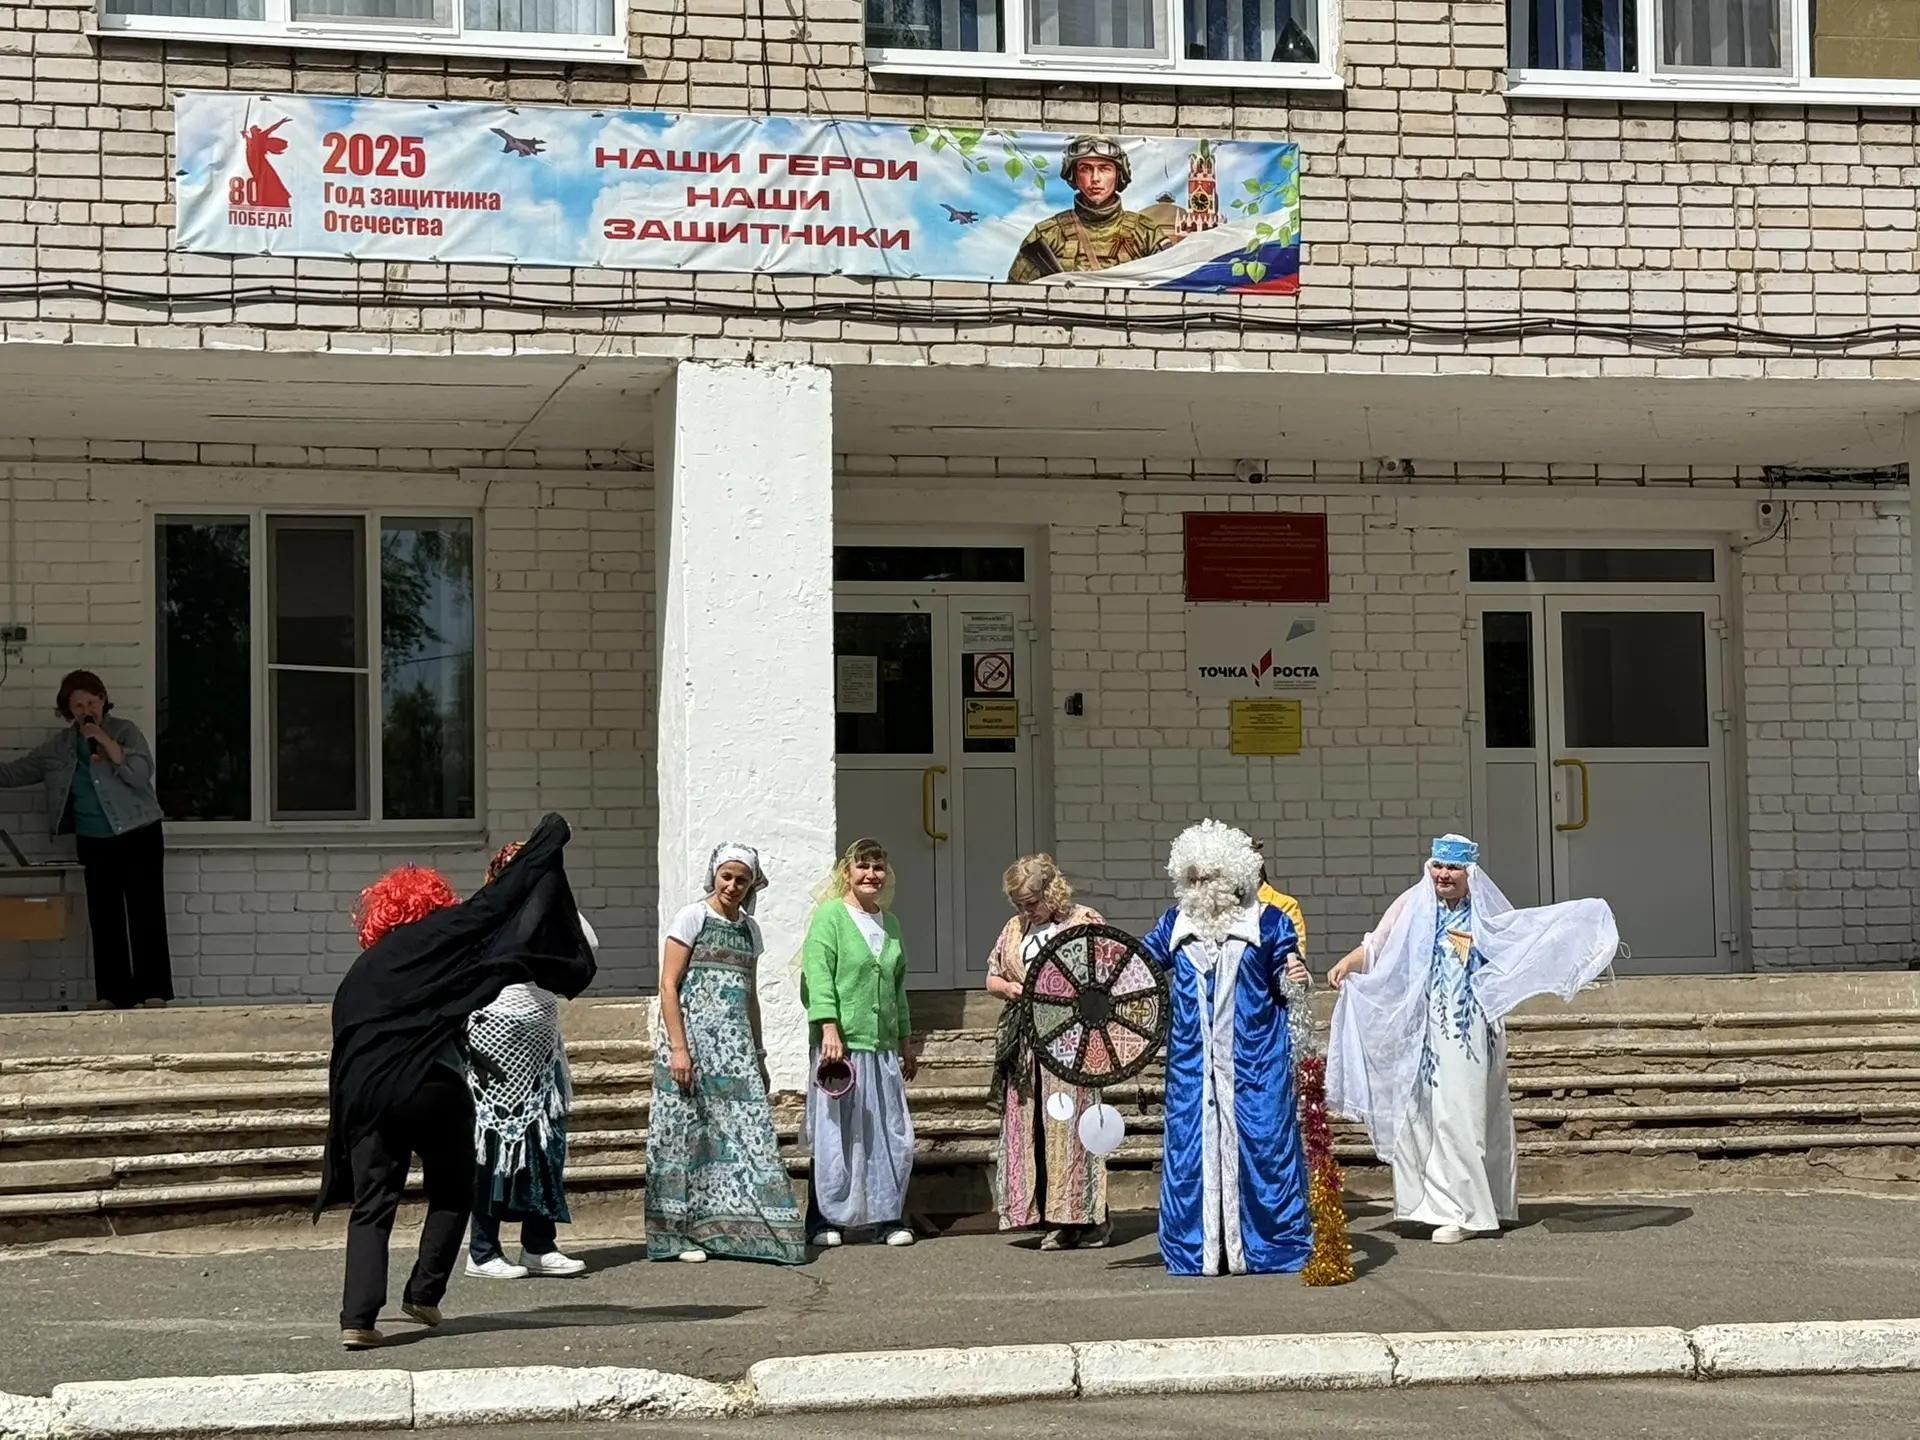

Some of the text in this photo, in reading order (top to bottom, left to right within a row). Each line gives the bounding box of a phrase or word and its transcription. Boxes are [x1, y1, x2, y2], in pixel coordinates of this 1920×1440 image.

[324, 133, 427, 177] 2025
[596, 147, 917, 180] НАШИ ГЕРОИ
[229, 176, 260, 206] 80
[324, 182, 500, 210] Год защитника
[687, 187, 830, 210] НАШИ
[228, 210, 292, 229] ПОБЕДА!
[324, 210, 443, 236] Отечества
[604, 219, 910, 250] ЗАЩИТНИКИ
[1198, 666, 1320, 678] ТОЧКА РОСТА
